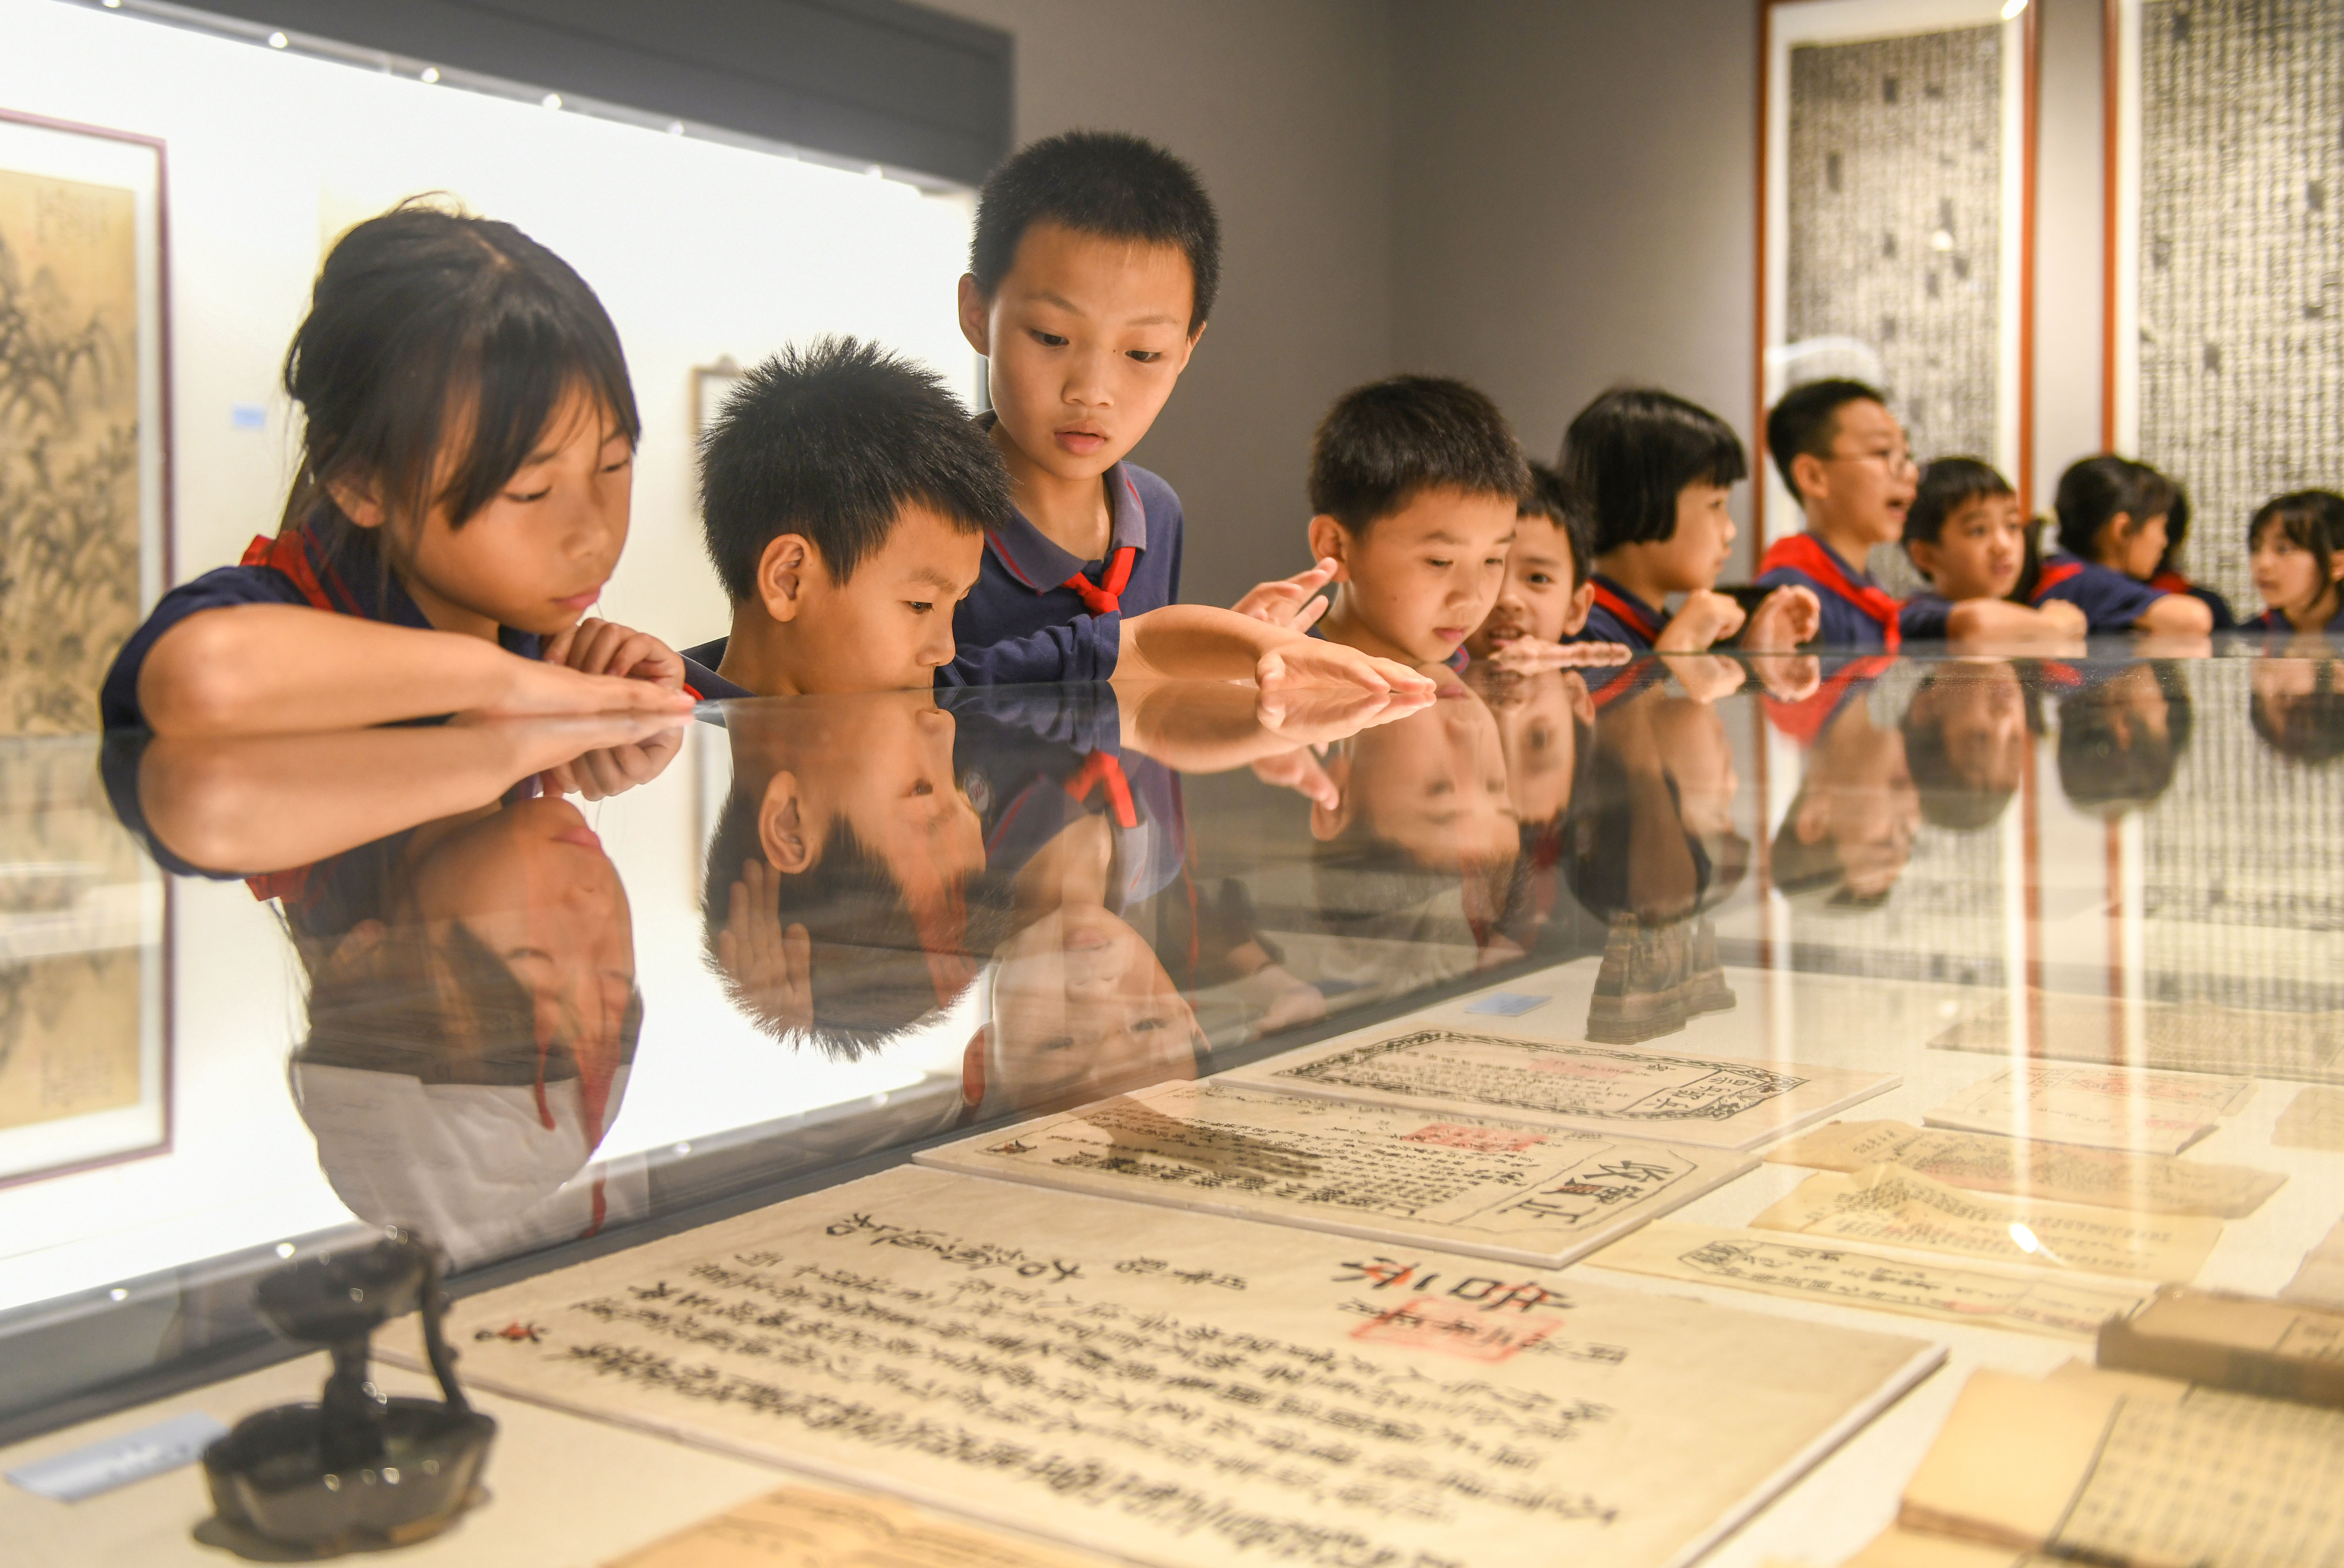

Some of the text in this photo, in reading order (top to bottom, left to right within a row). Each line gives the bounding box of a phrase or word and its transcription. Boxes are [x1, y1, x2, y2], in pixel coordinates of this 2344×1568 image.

[1497, 1160, 1674, 1224] 正實收
[1331, 1256, 1579, 1312] 告示
